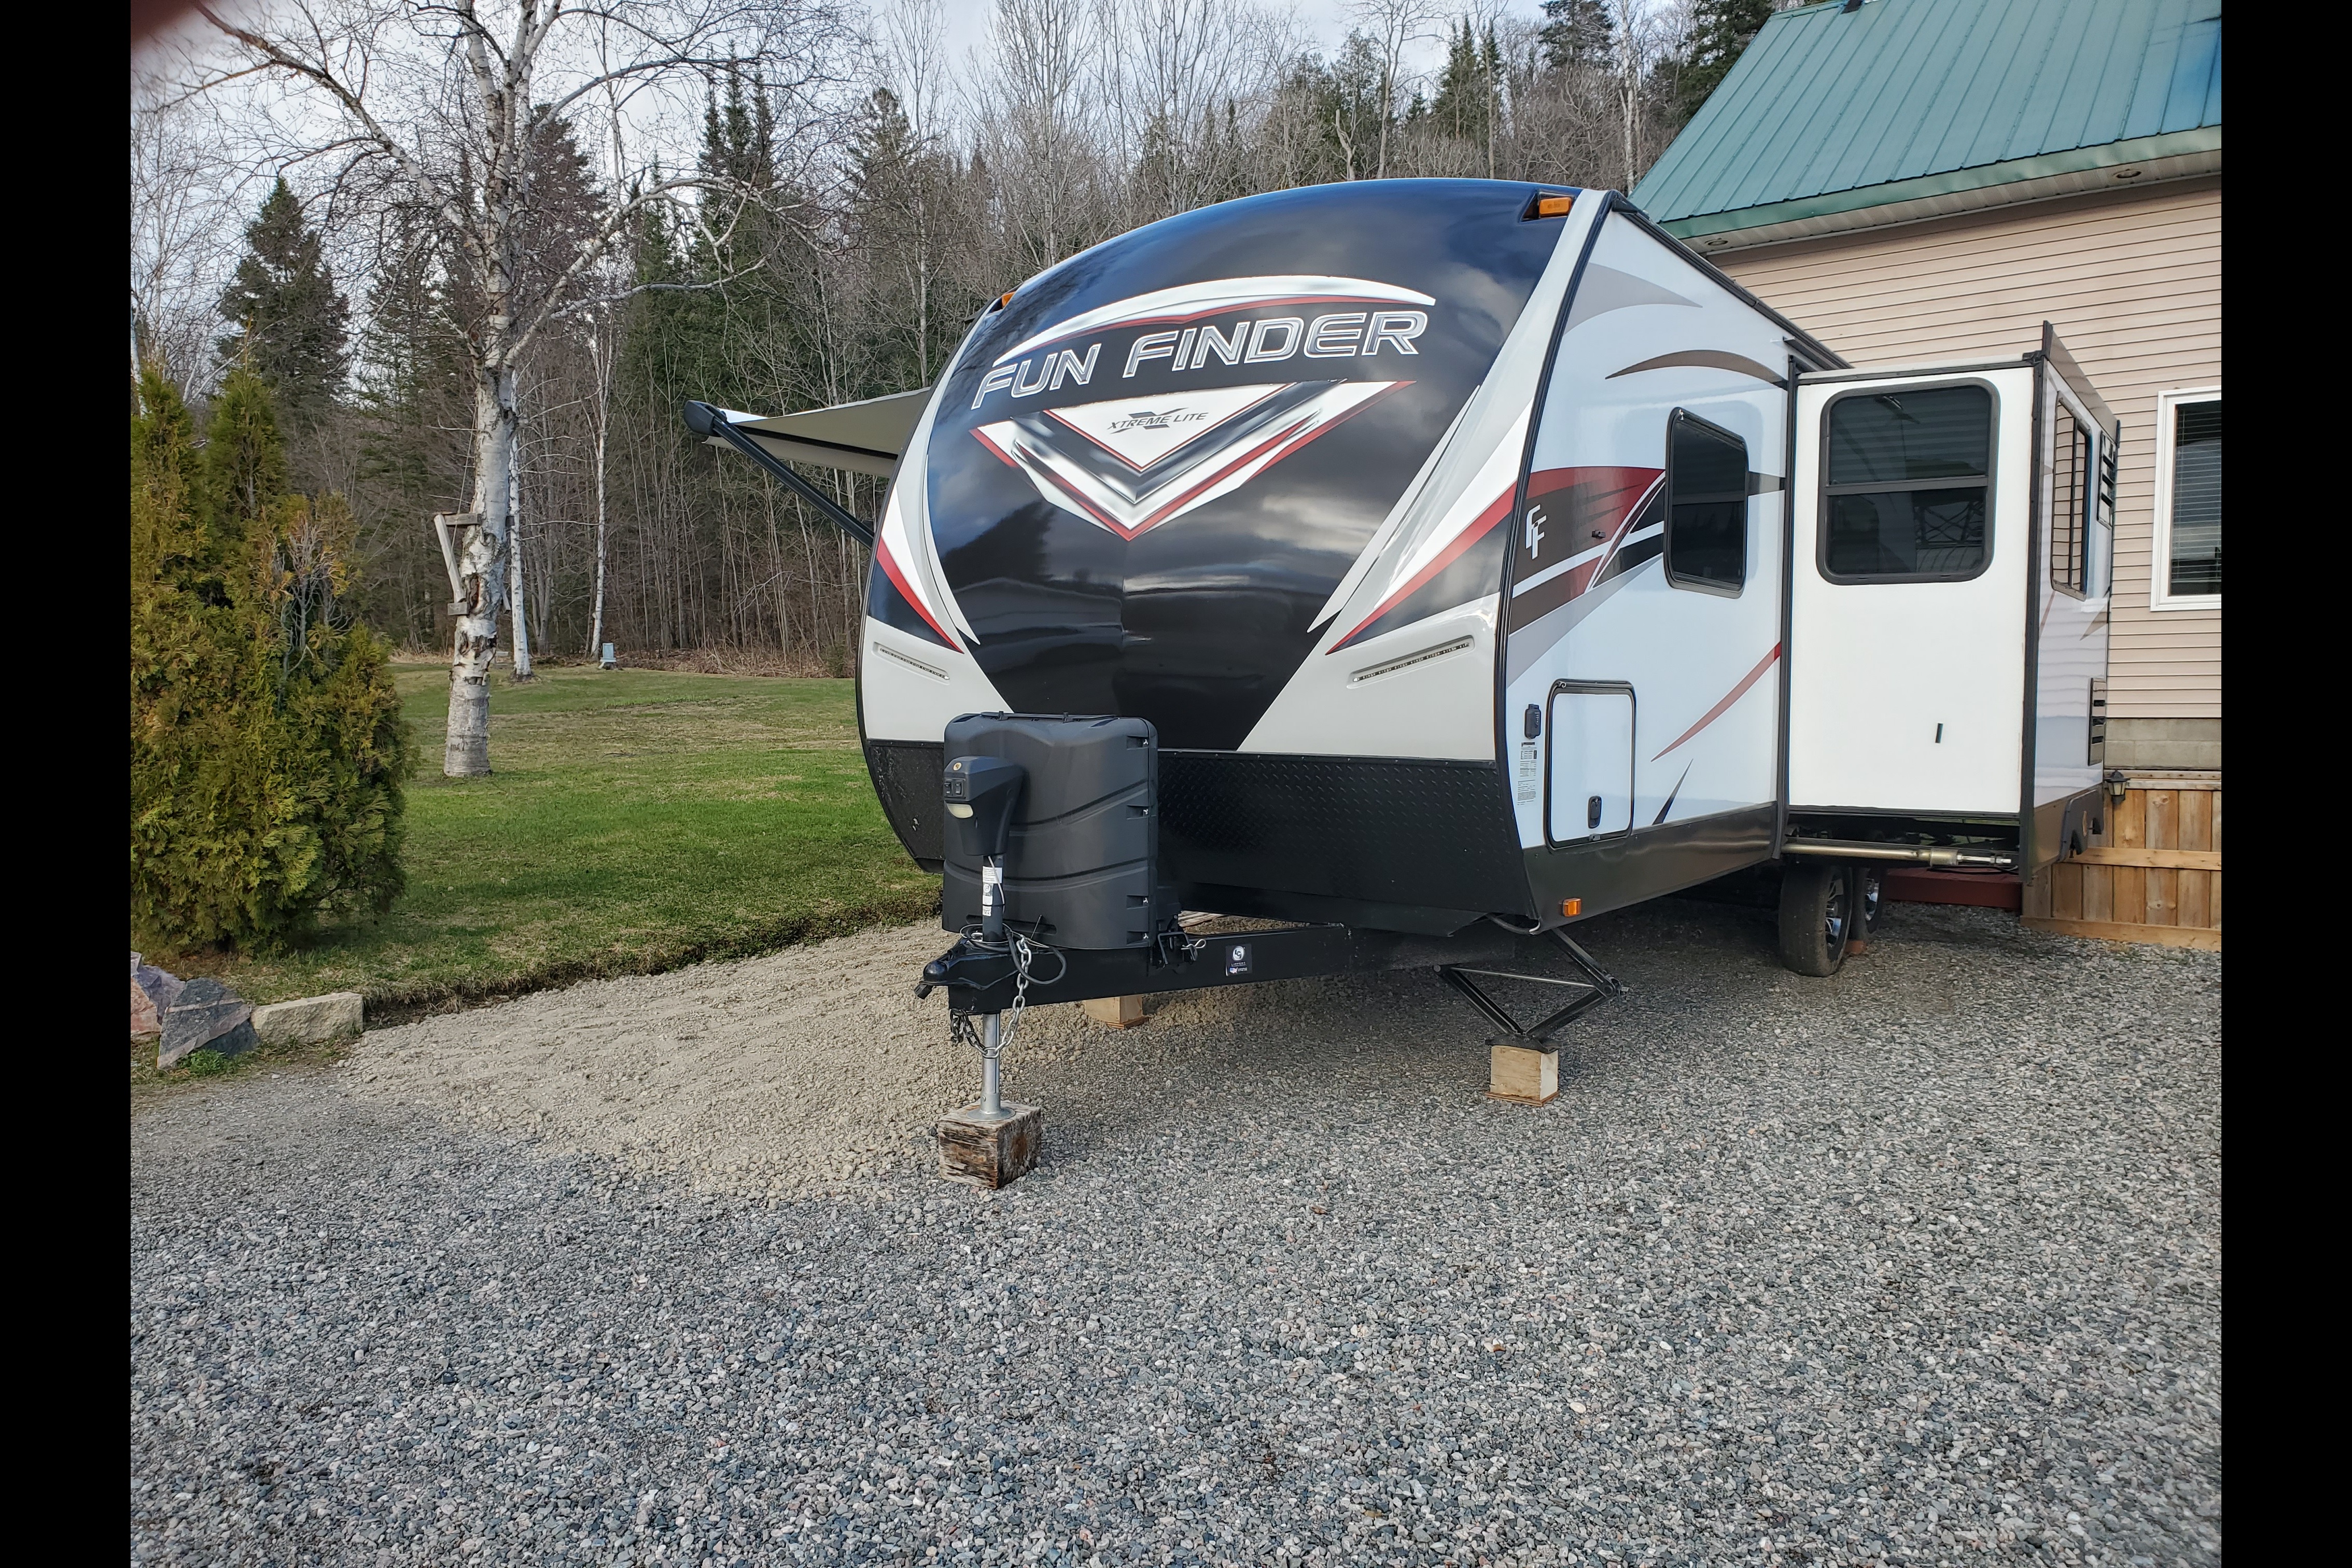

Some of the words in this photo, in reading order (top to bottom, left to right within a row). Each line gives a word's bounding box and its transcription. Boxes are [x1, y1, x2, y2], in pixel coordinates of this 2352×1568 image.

[971, 343, 1101, 410] FUN
[1123, 311, 1427, 377] FINDER
[1107, 416, 1172, 429] XTREME
[1173, 413, 1209, 422] LITE
